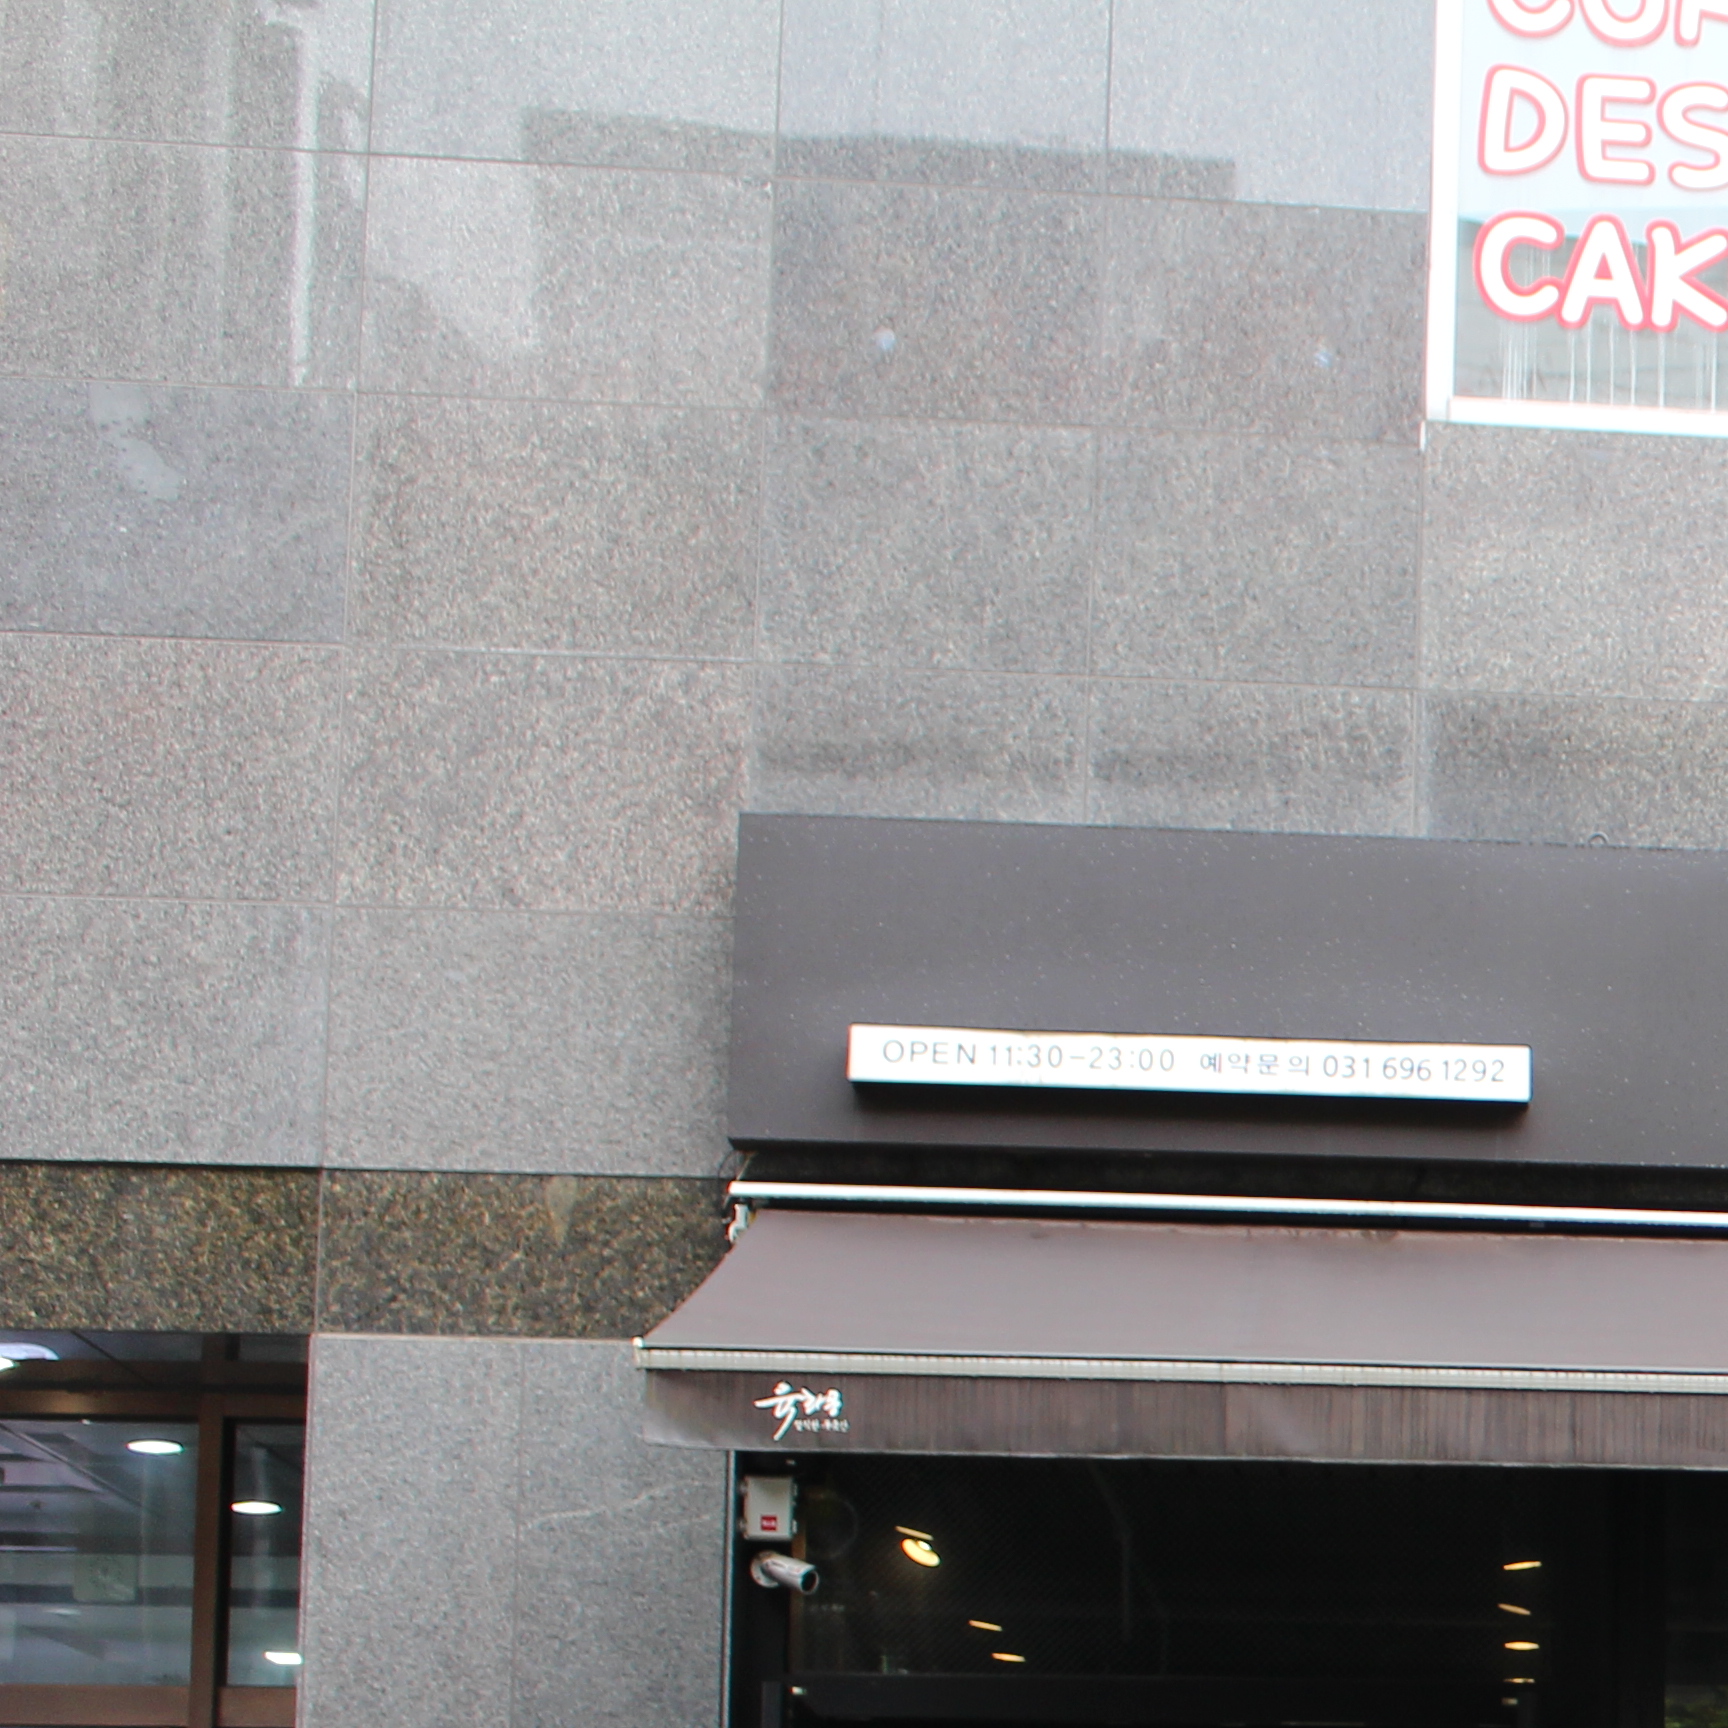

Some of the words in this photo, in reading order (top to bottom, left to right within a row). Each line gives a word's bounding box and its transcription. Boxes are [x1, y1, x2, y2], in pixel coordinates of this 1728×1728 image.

[882, 1039, 977, 1065] OPEN
[1200, 1052, 1310, 1077] 예약문의
[1322, 1054, 1371, 1079] 031
[1382, 1056, 1432, 1082] 696
[1441, 1058, 1505, 1083] 1292
